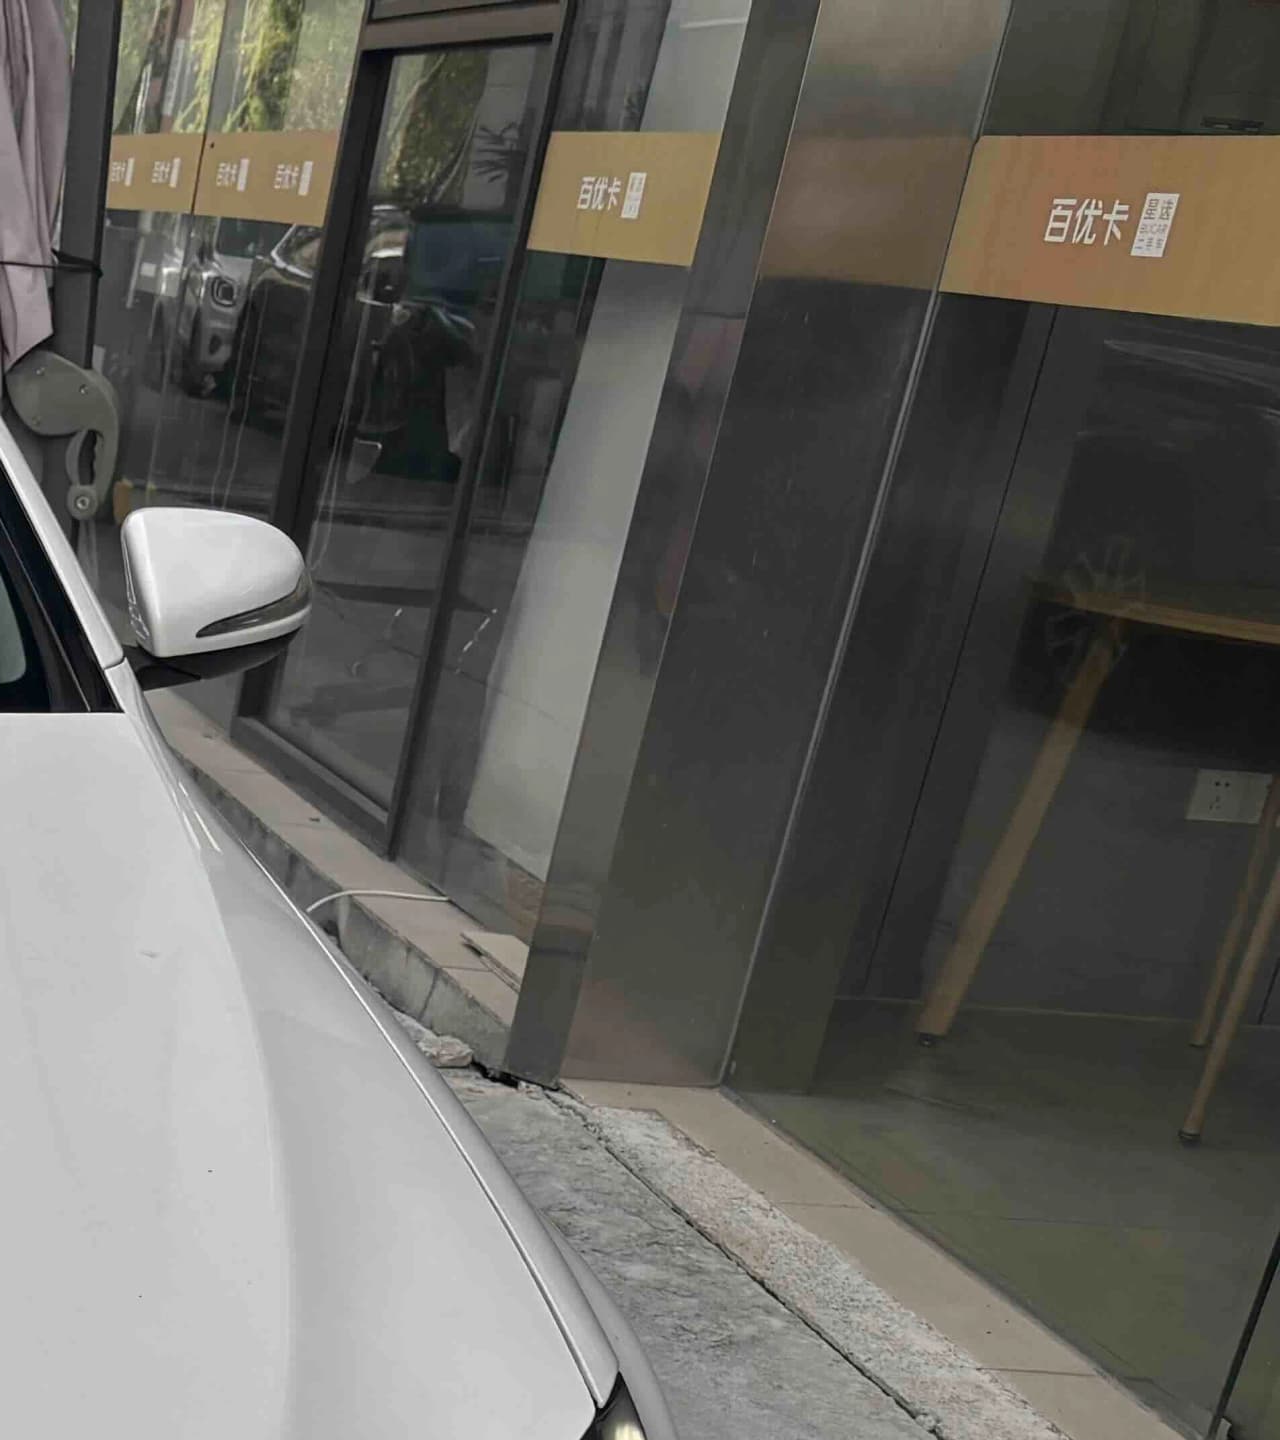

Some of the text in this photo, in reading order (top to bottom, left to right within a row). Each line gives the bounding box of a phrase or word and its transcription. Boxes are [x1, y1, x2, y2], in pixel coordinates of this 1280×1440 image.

[577, 176, 621, 210] 百优卡
[1044, 198, 1130, 245] 百优卡
